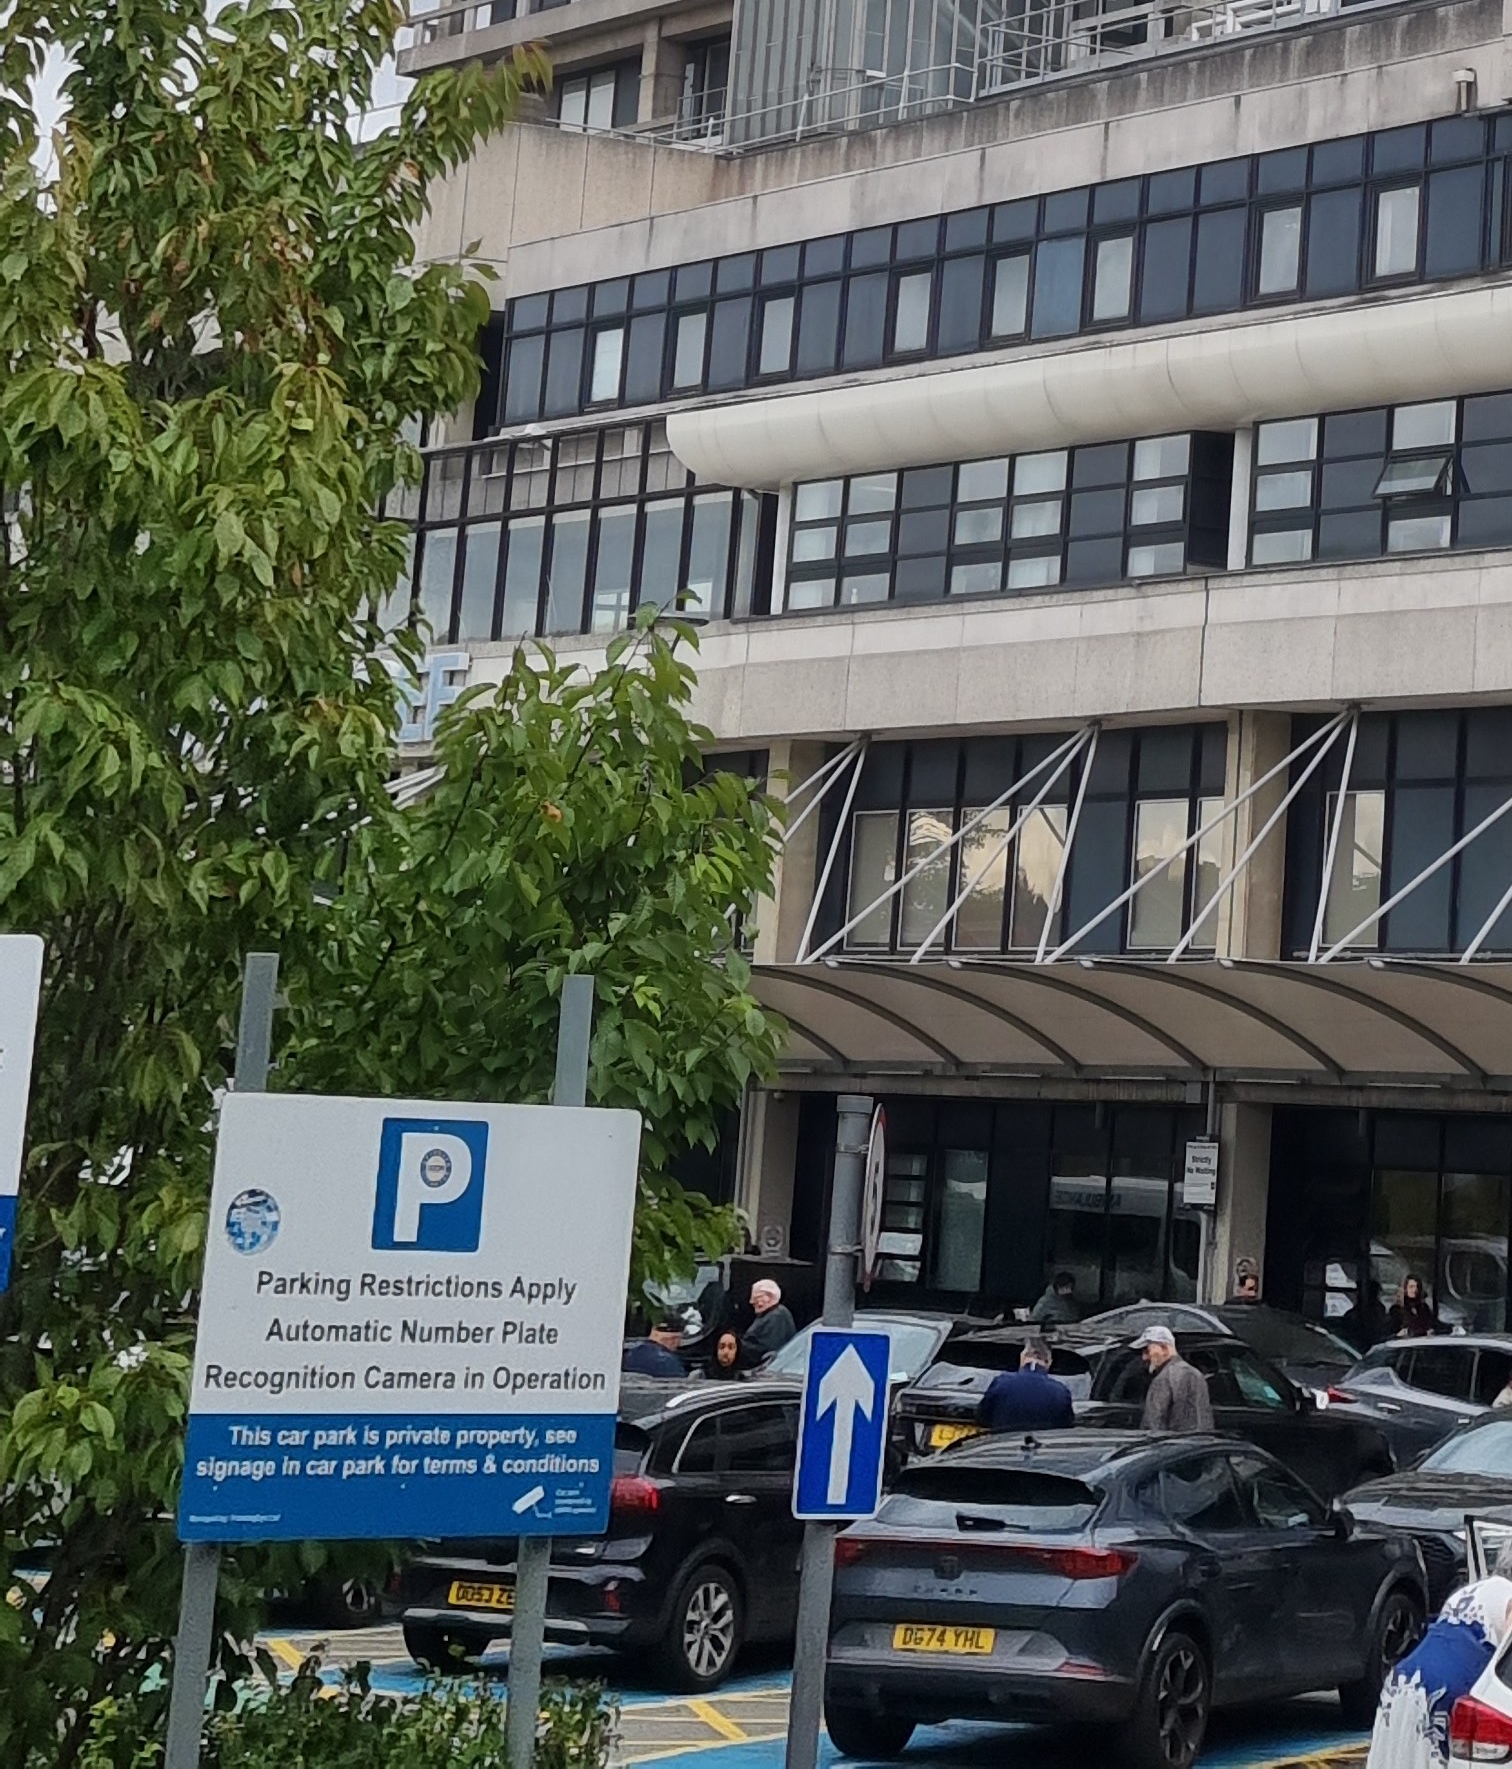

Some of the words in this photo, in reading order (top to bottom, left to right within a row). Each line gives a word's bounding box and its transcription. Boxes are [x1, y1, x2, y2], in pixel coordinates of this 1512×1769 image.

[393, 1133, 471, 1242] P
[256, 1271, 351, 1301] Parking
[359, 1272, 503, 1299] Restrictions
[509, 1275, 577, 1305] Apply
[265, 1318, 392, 1342] Automatic
[401, 1319, 494, 1344] Number
[501, 1320, 559, 1345] Plate
[204, 1364, 356, 1394] Recognition
[363, 1365, 456, 1389] Camera
[463, 1366, 485, 1389] in
[492, 1366, 606, 1395] Operation
[228, 1425, 271, 1446] This
[277, 1429, 310, 1446] car
[313, 1425, 358, 1450] park
[362, 1425, 380, 1446] is
[384, 1424, 451, 1450] private
[456, 1425, 540, 1450] property,
[545, 1429, 577, 1444] see
[196, 1456, 276, 1481] signage
[281, 1455, 301, 1476] in
[305, 1459, 338, 1476] car
[342, 1455, 387, 1480] park
[391, 1454, 419, 1474] for
[423, 1455, 478, 1475] terms
[482, 1453, 498, 1474] &
[502, 1454, 600, 1474] conditions
[902, 1627, 947, 1647] DG74
[953, 1630, 985, 1649] YHL
